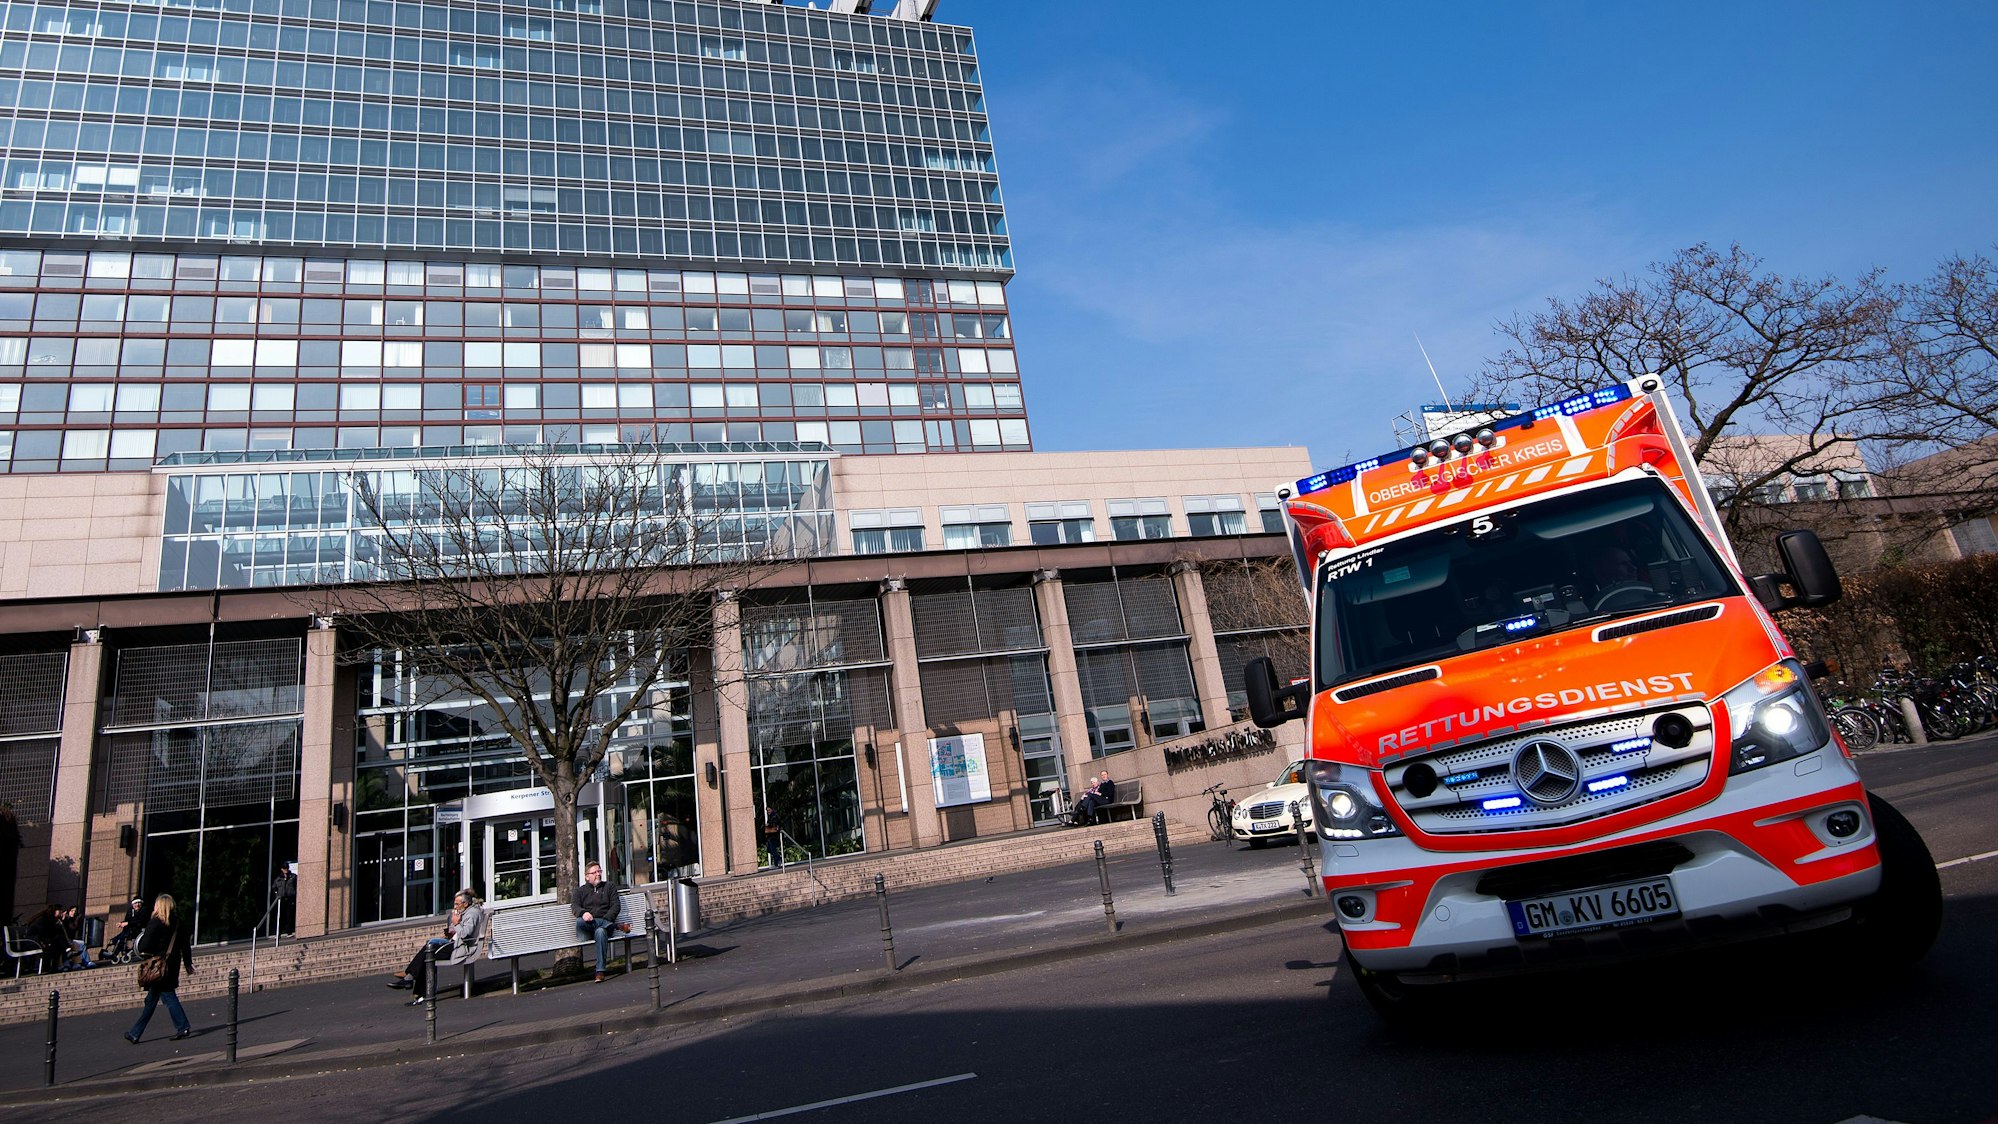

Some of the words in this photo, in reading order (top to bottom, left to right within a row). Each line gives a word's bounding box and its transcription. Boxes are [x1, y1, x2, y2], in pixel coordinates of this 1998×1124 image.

[1369, 453, 1511, 504] OBERBERGISCHER
[1514, 439, 1564, 462] KREIS
[1472, 515, 1494, 535] 5
[1327, 561, 1362, 583] RTW
[1365, 557, 1373, 567] 1
[1328, 557, 1356, 571] Rettung
[1378, 672, 1695, 755] RETTUNGSDIENST
[1525, 901, 1560, 929] GM
[1569, 894, 1603, 923] KV
[1611, 883, 1672, 916] 6605
